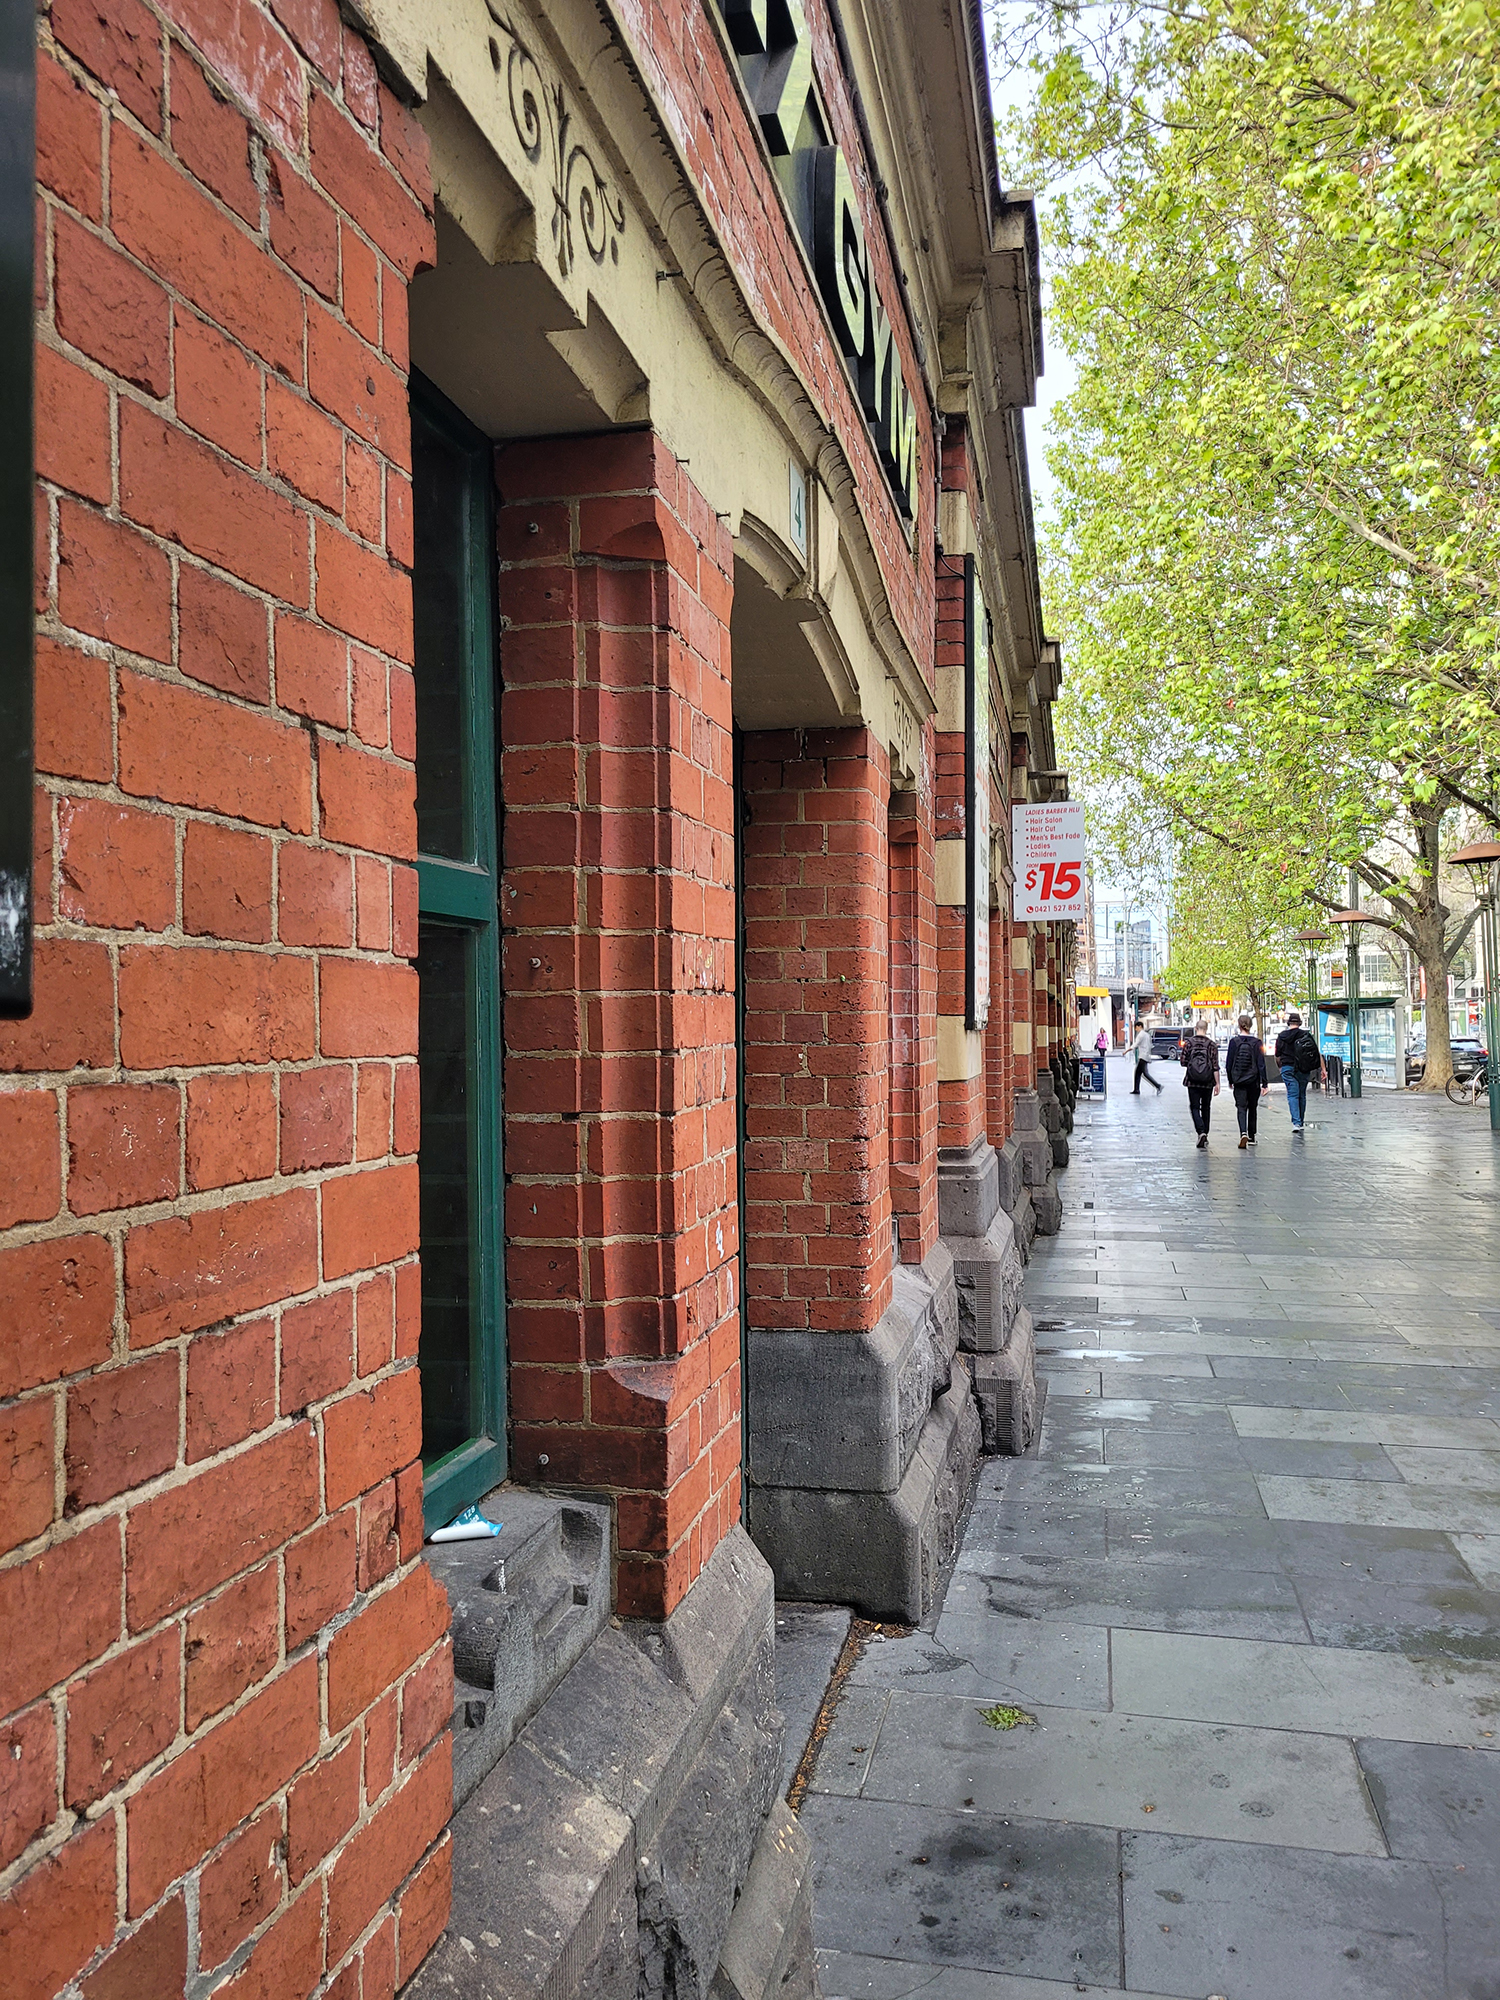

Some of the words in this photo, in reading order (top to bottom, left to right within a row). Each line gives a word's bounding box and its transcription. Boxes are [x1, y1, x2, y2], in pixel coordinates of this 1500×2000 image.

[833, 144, 919, 522] GYM
[794, 486, 802, 539] 4
[1025, 808, 1045, 816] LADIES
[1046, 807, 1068, 815] BARBER
[1045, 816, 1063, 824] Salon
[1065, 832, 1080, 840] Fade
[1034, 905, 1051, 913] 0421
[1053, 904, 1066, 912] 527
[1068, 903, 1081, 912] 852
